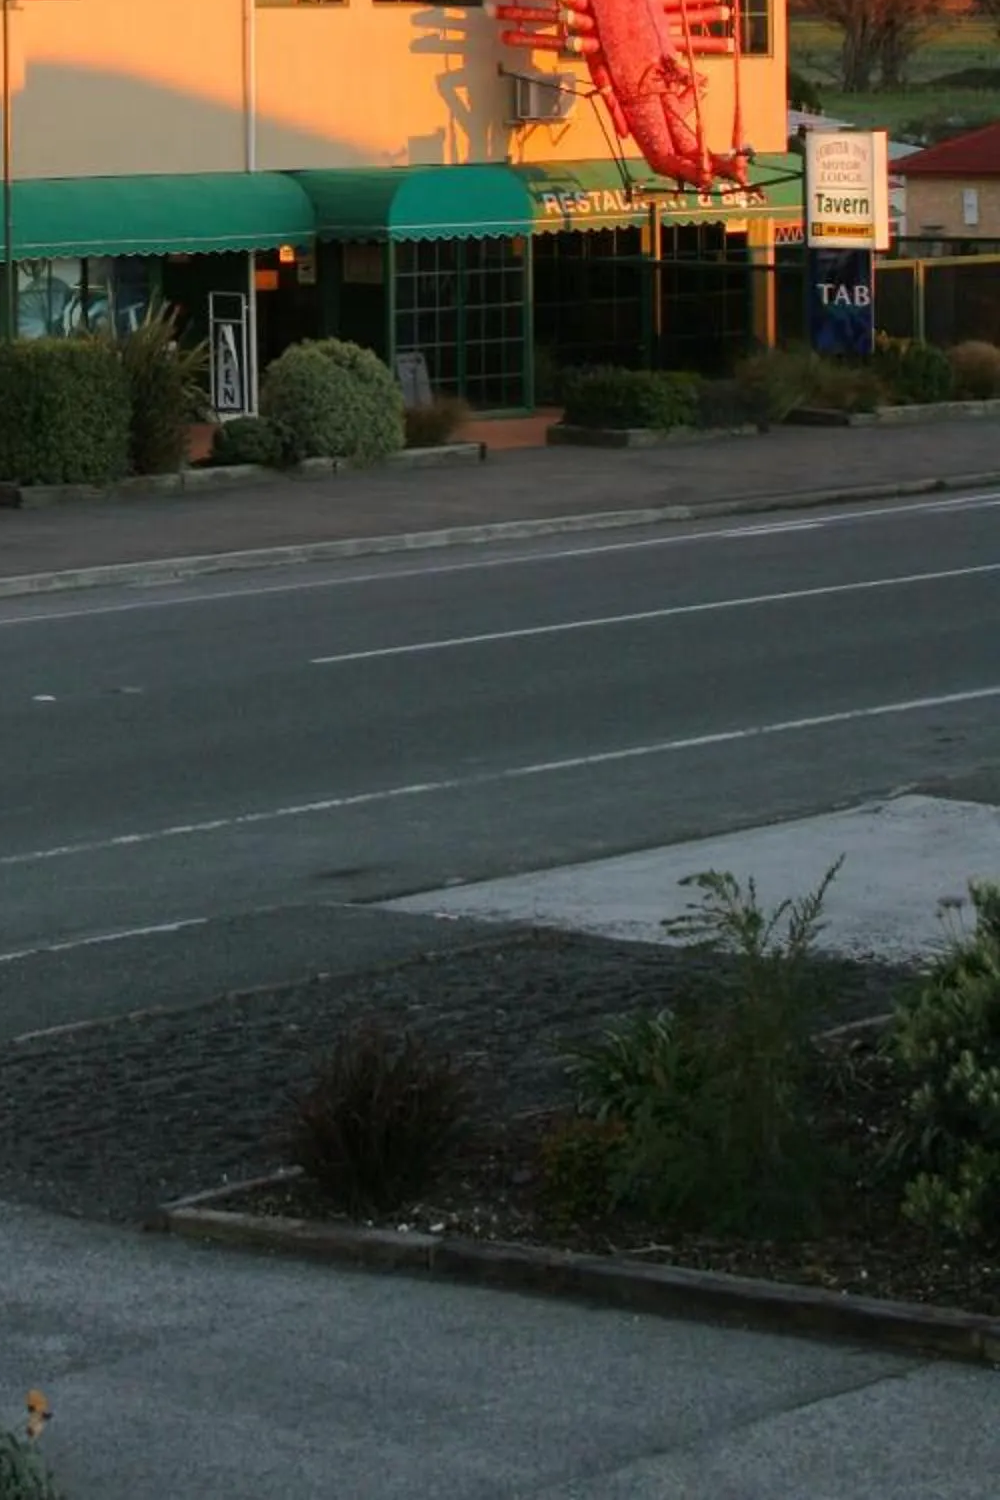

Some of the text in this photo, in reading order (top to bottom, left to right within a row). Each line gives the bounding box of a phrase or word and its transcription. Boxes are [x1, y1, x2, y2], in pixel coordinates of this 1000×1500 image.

[543, 185, 687, 215] RESTAU
[814, 193, 869, 214] Tavern
[815, 283, 870, 306] TAB
